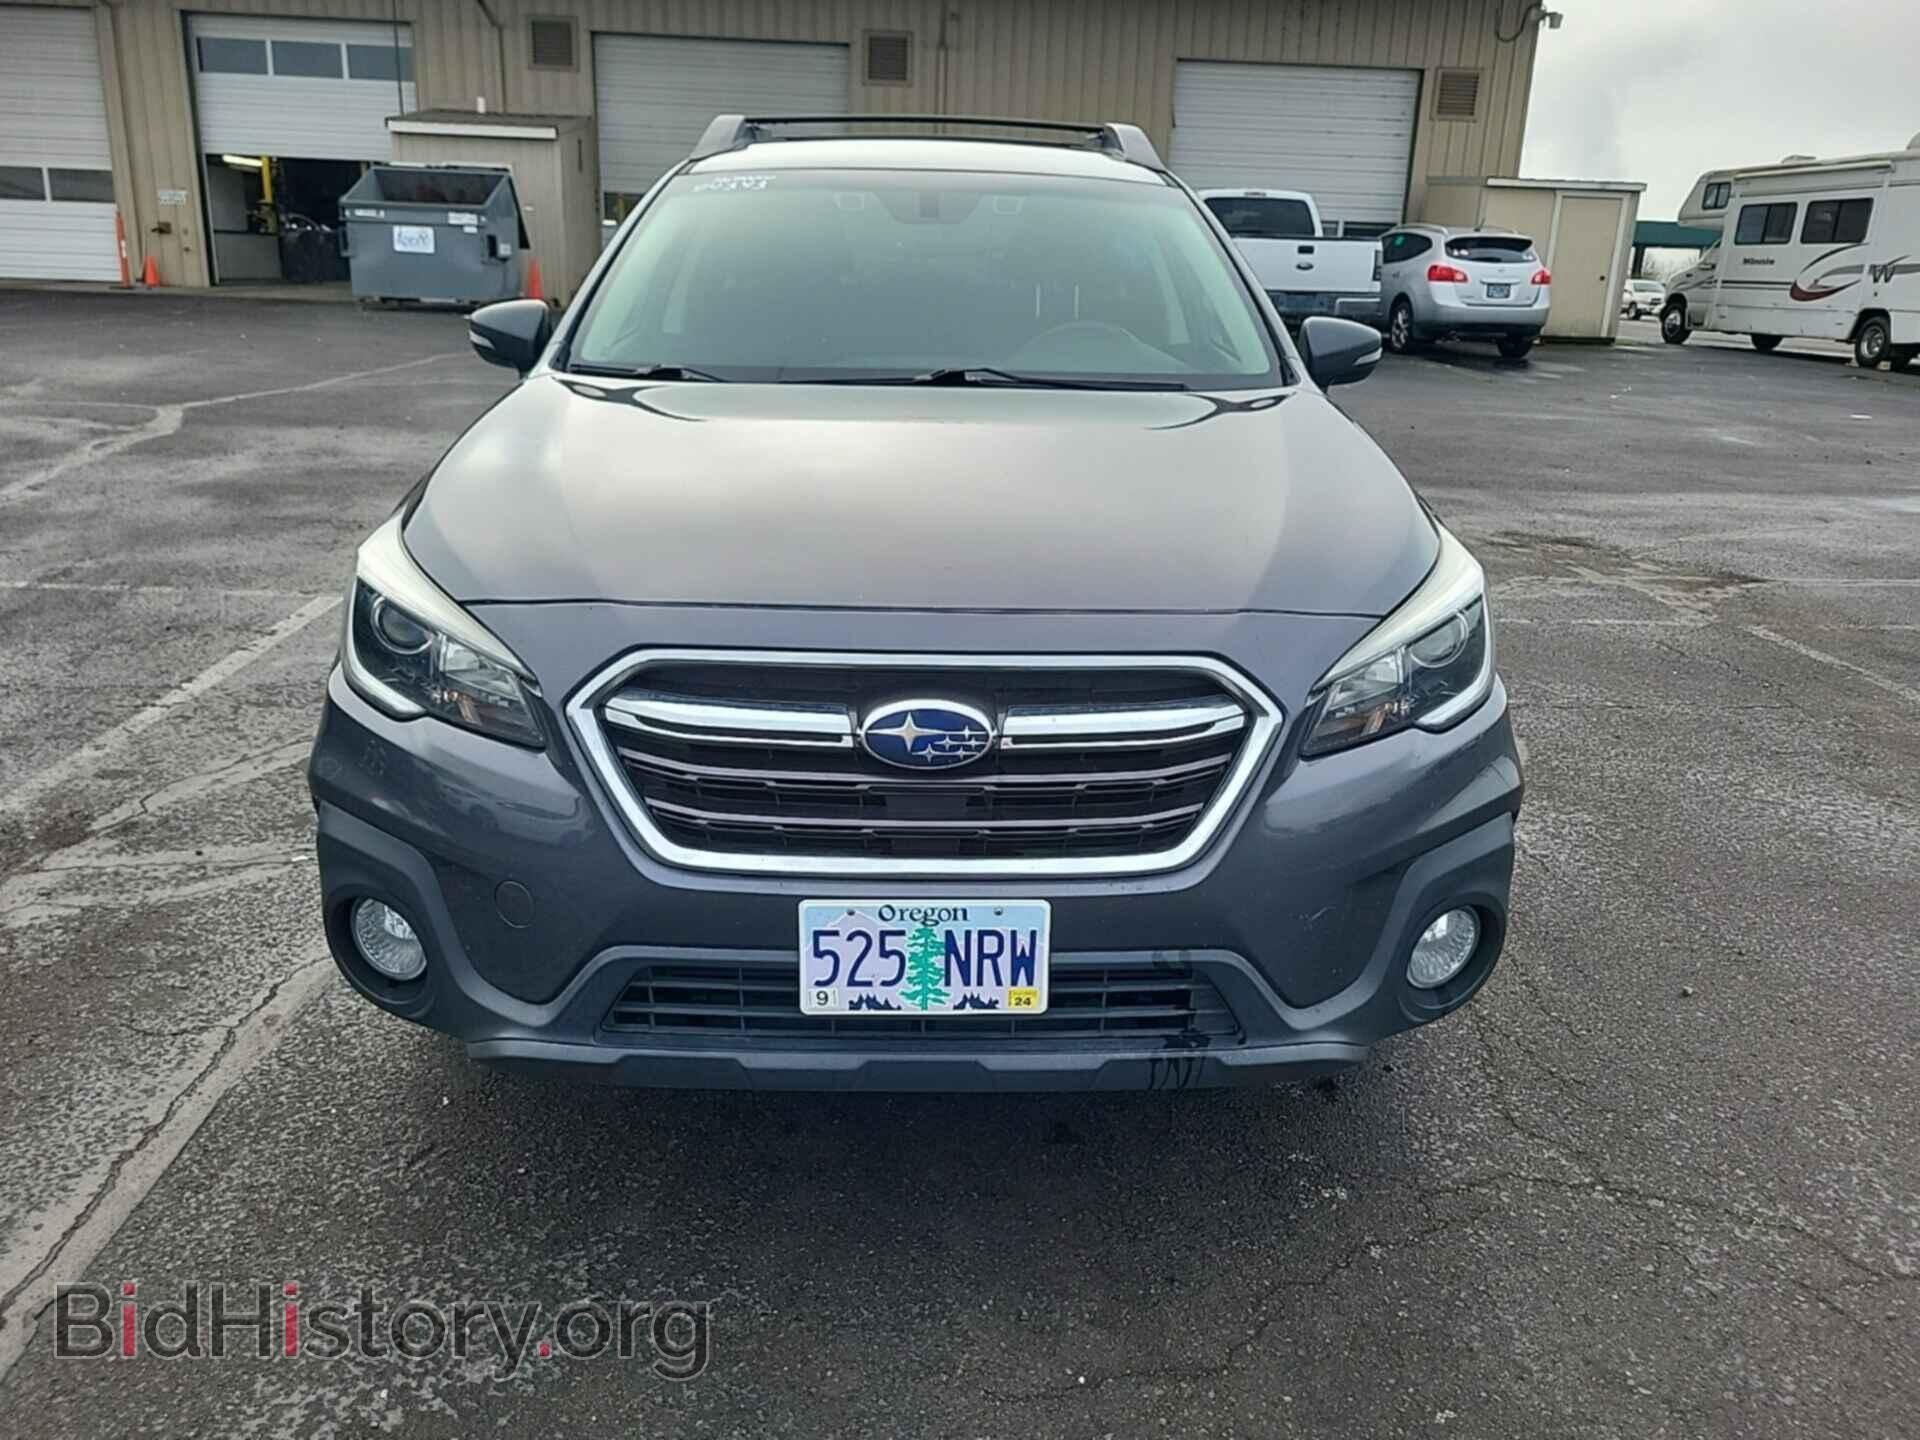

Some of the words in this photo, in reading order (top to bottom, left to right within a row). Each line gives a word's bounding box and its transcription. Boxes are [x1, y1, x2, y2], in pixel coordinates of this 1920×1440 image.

[878, 904, 969, 927] Oregon
[811, 929, 907, 987] 525
[944, 929, 1037, 987] NRW
[815, 990, 829, 1006] 9
[1014, 996, 1032, 1007] 24
